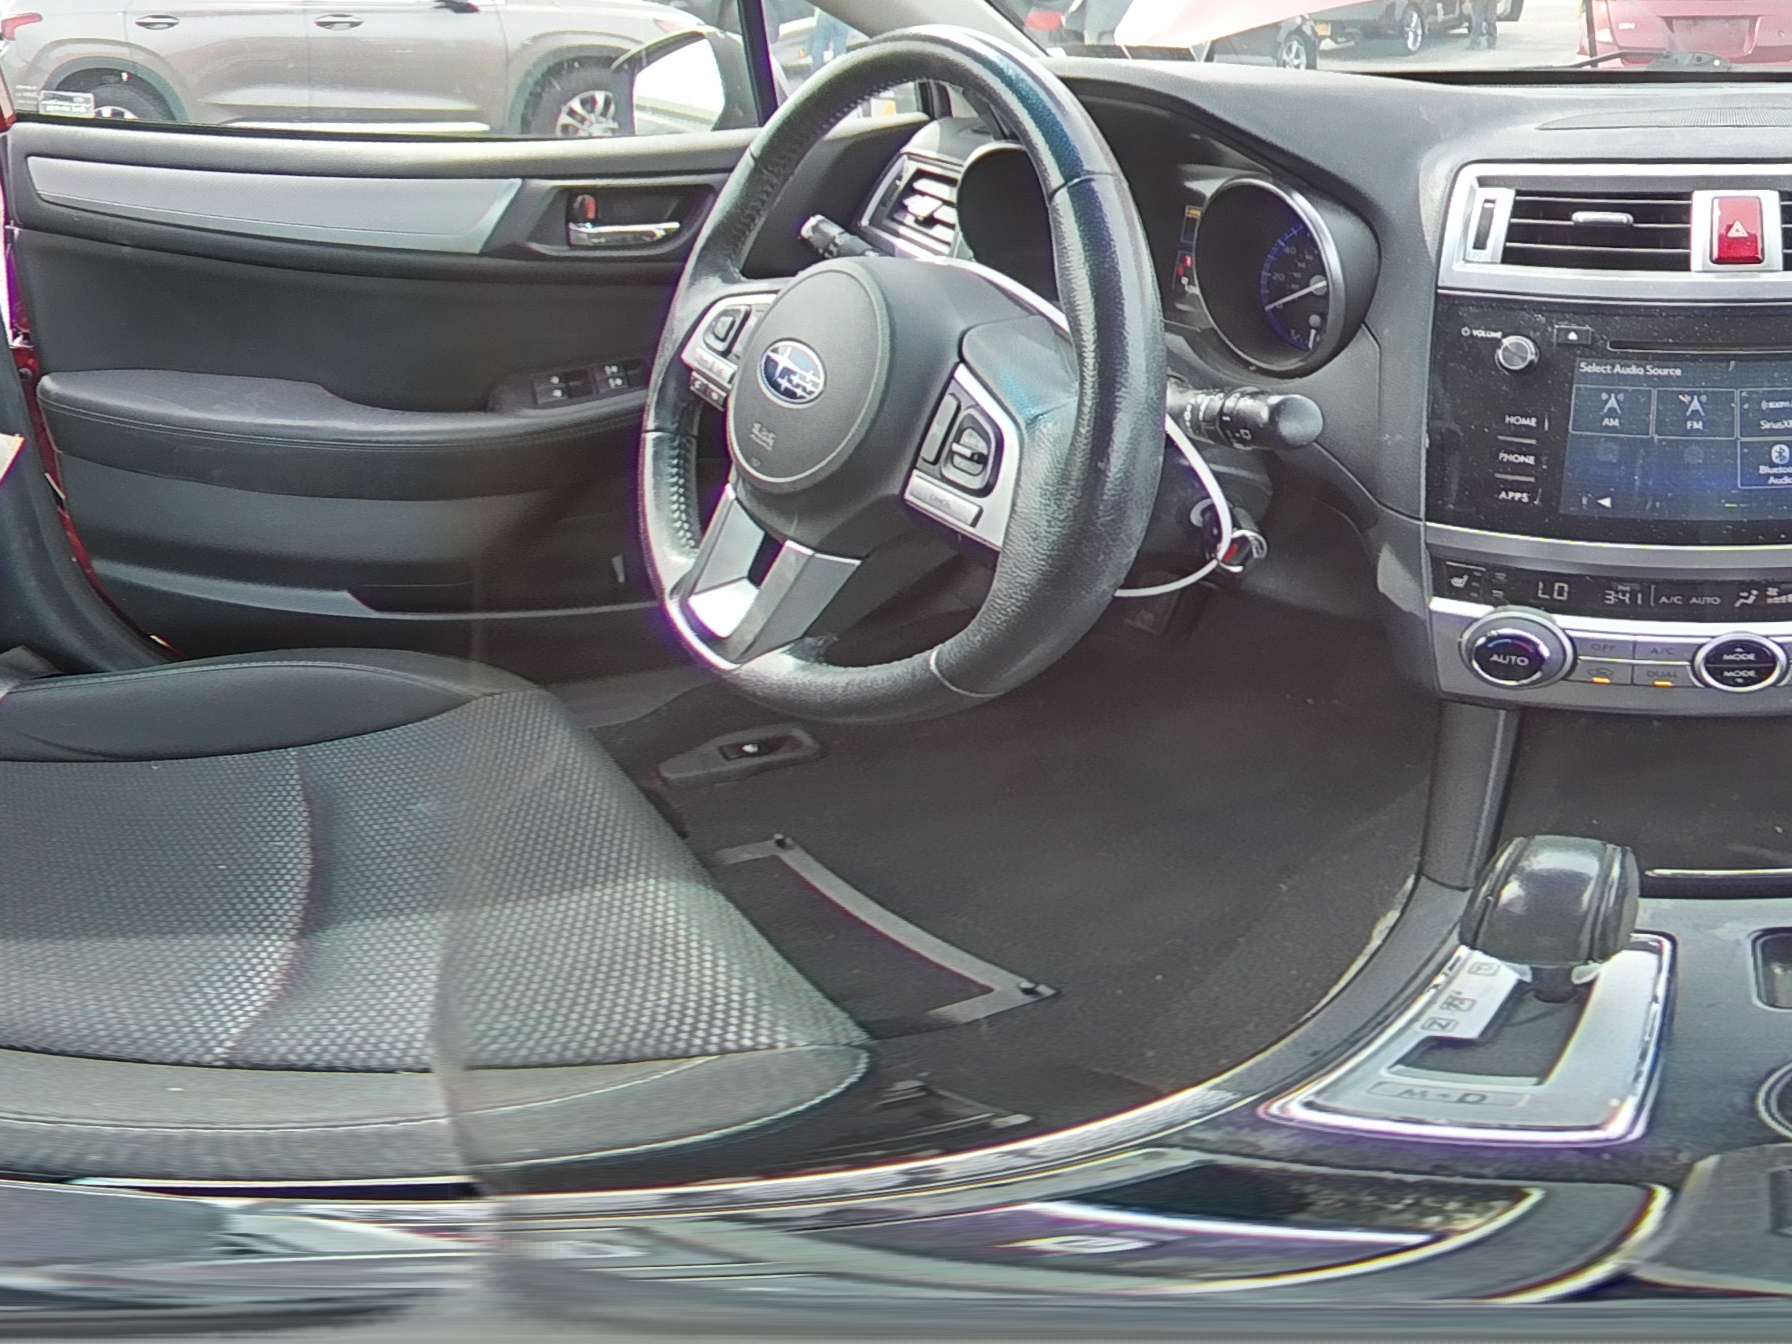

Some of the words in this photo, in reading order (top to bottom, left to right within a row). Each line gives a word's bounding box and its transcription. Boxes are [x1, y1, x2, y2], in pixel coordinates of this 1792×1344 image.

[1472, 329, 1503, 339] VOLUME
[1580, 362, 1611, 373] Select
[1614, 364, 1643, 375] Audio
[1646, 365, 1682, 376] Source
[1504, 415, 1537, 427] HOME
[1602, 417, 1620, 427] AM
[1687, 420, 1703, 430] FM
[1498, 452, 1535, 465] PHONE
[1498, 491, 1529, 503] APPS
[1537, 581, 1568, 600] LO
[1659, 596, 1683, 604] A/C
[1690, 596, 1721, 605] AUTO
[1591, 643, 1615, 652] OFF
[1651, 647, 1675, 655] A/C
[1489, 653, 1529, 666] AUTO
[1647, 670, 1678, 678] DUAL
[1455, 1093, 1488, 1103] D
